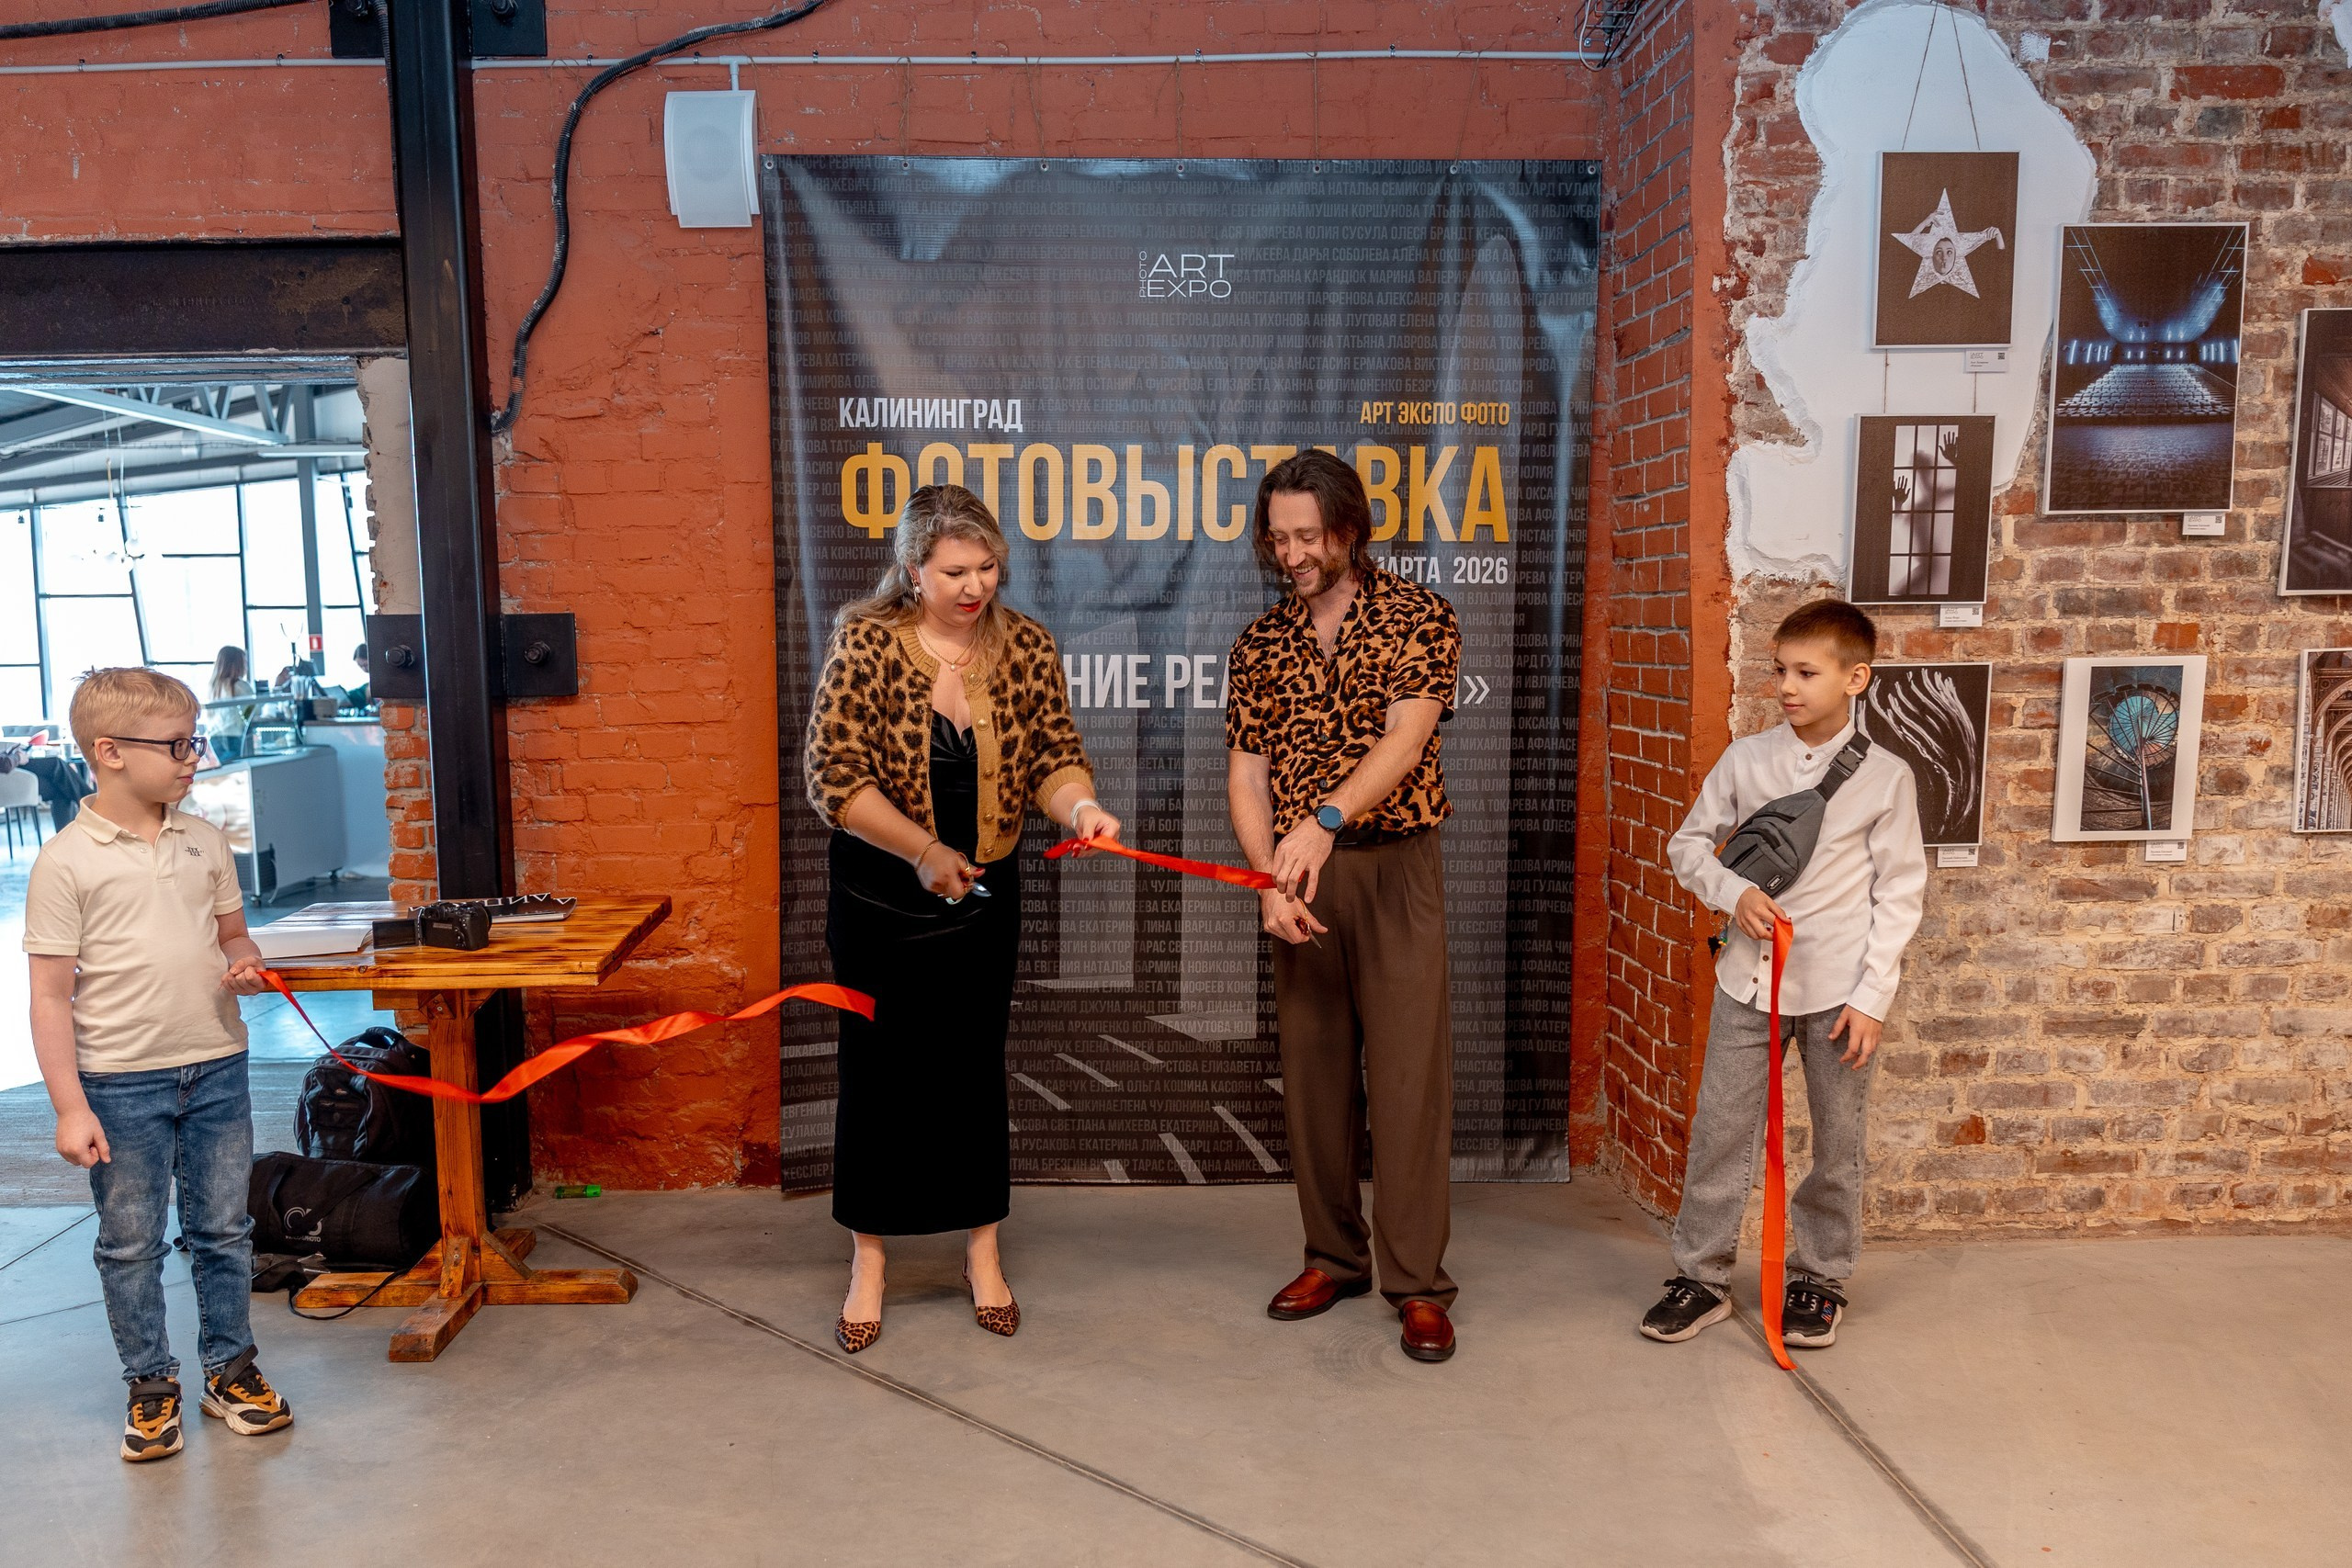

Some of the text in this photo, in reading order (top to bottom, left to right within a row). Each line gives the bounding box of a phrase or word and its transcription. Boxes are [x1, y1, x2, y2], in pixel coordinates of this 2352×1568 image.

[873, 178, 912, 192] ЛИЛИЯ
[1015, 181, 1051, 194] ЕЛЕНА
[1155, 181, 1218, 194] ЧУЛЮНИНА
[1223, 182, 1262, 196] ЖАННА
[1265, 182, 1324, 196] КАРИМОВА
[1329, 182, 1378, 196] НАТАЛЬЯ
[1382, 182, 1441, 196] СЕМИКОВА
[1509, 182, 1555, 197] ЭДУАРД
[827, 200, 1470, 218] ТАТЬЯНА ТАРАСОВА СВЕТЛАНА МИХЕЕВА ЕКАТЕРИНА ЕВГЕНИЙ НАЙМУШИН КОРШУНОВА ТАТЬЯНА
[1020, 224, 1474, 241] РУСАКОВА ЕКАТЕРИНА ЛИНА АСЯ ЛАЗАРЕВА ЮЛИЯ СУСУЛА ОЛЕСЯ БРАНДТ
[1091, 245, 1133, 259] ВИКТОР
[1293, 247, 1329, 263] ДАРЬЯ
[1332, 247, 1389, 261] СОБОЛЕВА
[1148, 254, 1235, 278] ART
[1034, 267, 1467, 285] ЕВГЕНИЯ ТАТЬЯНА КАРАНДЮК МАРИНА ВАЛЕРИЯ
[1139, 251, 1148, 298] PHOTO
[1148, 279, 1232, 299] EXPO
[1235, 291, 1305, 305] КОНСТАНТИН
[1307, 291, 1374, 305] ПАРФЕНОВА
[1377, 291, 1450, 307] АЛЕКСАНДРА
[1453, 292, 1510, 305] СВЕТЛАНА
[1040, 311, 1076, 325] МАРИЯ
[1080, 311, 1123, 327] ДЖУНА
[1161, 311, 1209, 325] ПЕТРОВА
[1212, 313, 1249, 328] ДИАНА
[1254, 313, 1310, 327] ТИХОНОВА
[1313, 313, 1342, 327] АННА
[1346, 313, 1396, 327] ЛУГОВАЯ
[1400, 313, 1435, 327] ЕЛЕНА
[1493, 313, 1525, 327] ЮЛИЯ
[814, 332, 1497, 349] МИХАИЛ КСЕНИЯ МАРИНА АРХИПЕНКО ЮЛИЯ БАХМУТОВА ЮЛИЯ МИШКИНА ТАТЬЯНА ЛАВРОВА ВЕРОНИКА
[826, 353, 1555, 372] КАТЕРИНА ЕЛЕНА АНДРЕЙ БОЛЬШАКОВ ГРОМОВА АНАСТАСИЯ ЕРМАКОВА ВИКТОРИЯ ВЛАДИМИРОВА
[1021, 378, 1532, 392] АНАСТАСИЯ ОСТАНИНА ФИРСТОВА ЕЛИЗАВЕТА ЖАННА ФИЛИМОНЕНКО БЕЗРУКОВА АНАСТАСИЯ
[1047, 399, 1343, 413] САВЧУК ЕЛЕНА ОЛЬГА КОШИНА КАСОЯН КАРИНА ЮЛИЯ
[1361, 400, 1510, 425] АРТ ЭКСПО ФОТО
[839, 397, 1023, 433] КАЛИНИНГРАД
[840, 442, 1510, 544] ФТОВЫСВКА
[1453, 556, 1509, 584] 2026
[1489, 717, 1559, 729] АННА ОКСАНА
[1442, 758, 1498, 771] СВЕТЛАНА
[1481, 776, 1555, 791] ЮЛИЯ ВОЙНОВ
[1487, 799, 1538, 812] ТОКАРЕВА
[1544, 819, 1576, 831] ОЛЕСЯ
[1459, 840, 1518, 852] АНАСТАСИЯ
[1449, 860, 1484, 872] ЕЛЕНА
[1488, 880, 1530, 895] ЭДУАРД
[1109, 900, 1221, 912] МИХЕЕВА ЕКАТЕРИНА
[1080, 920, 1235, 934] ЕКАТЕРИНА ЛИНА ШВАРЦ АСЯ
[1459, 920, 1505, 932] КЕССЛЕР
[1091, 941, 1223, 953] ВИКТОР ТАРАС СВЕТЛАНА
[1083, 960, 1243, 973] НАТАЛЬЯ НОВИКОВА
[1454, 958, 1518, 973] МИХАЙЛОВА
[1079, 1000, 1119, 1014] ДЖУНА
[1476, 1001, 1506, 1013] ЮЛИЯ
[1022, 1020, 1129, 1032] МАРИНА АРХИПЕНКО
[1482, 1021, 1532, 1032] ТОКАРЕВА
[1075, 1040, 1275, 1053] ЕЛЕНА БОЛЬШАКОВ ГРОМОВА
[1455, 1041, 1533, 1054] ВЛАДИМИРОВА
[1202, 1060, 1262, 1073] ЕЛИЗАВЕТА
[1127, 1080, 1251, 1093] ОЛЬГА КОШИНА КАСОЯН
[1536, 1080, 1569, 1091] ИРИНА
[1150, 1100, 1210, 1112] ЧУЛЮНИНА
[1108, 1120, 1219, 1133] МИХЕЕВА ЕКАТЕРИНА
[1022, 1139, 1138, 1152] РУСАКОВА ЕКАТЕРИНА
[1453, 1138, 1499, 1150] КЕССЛЕР
